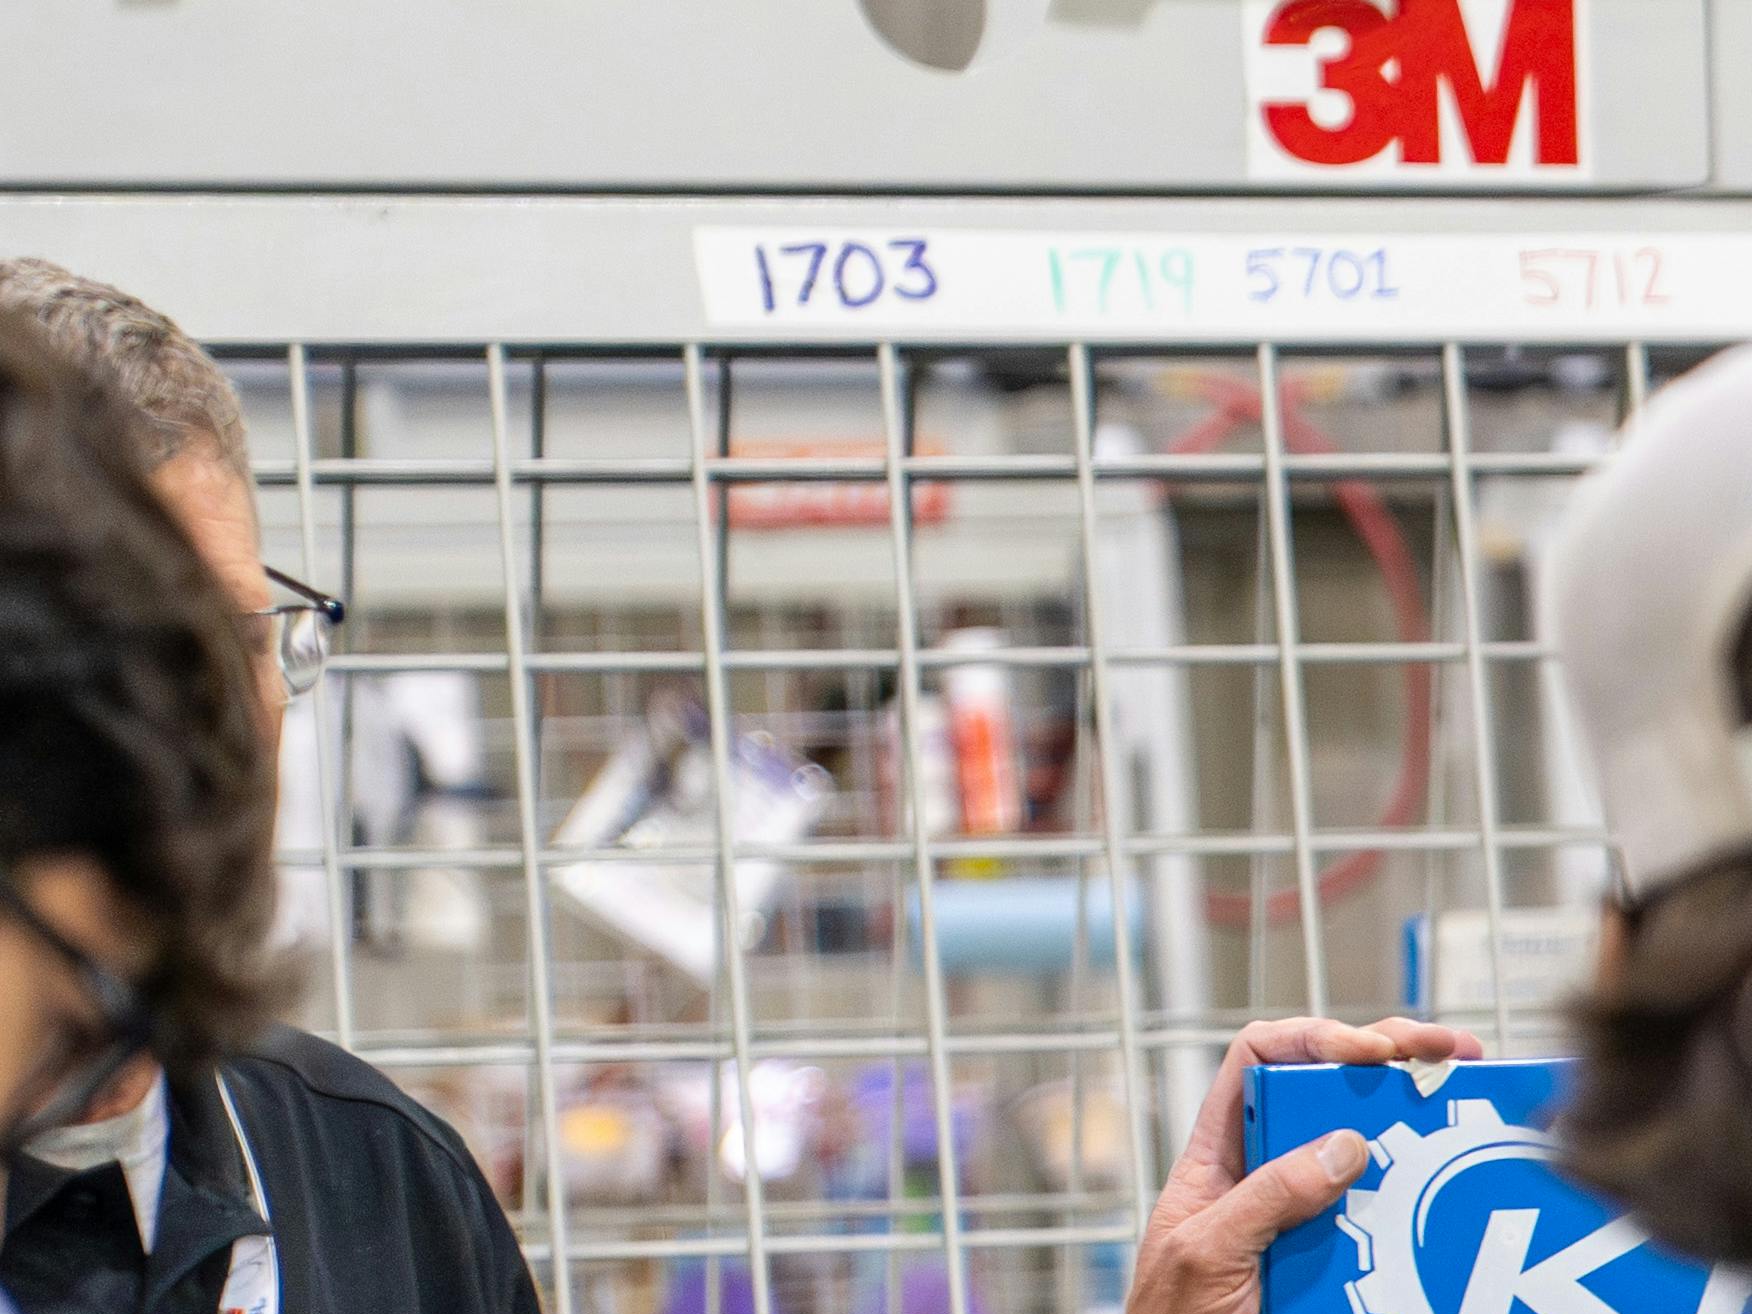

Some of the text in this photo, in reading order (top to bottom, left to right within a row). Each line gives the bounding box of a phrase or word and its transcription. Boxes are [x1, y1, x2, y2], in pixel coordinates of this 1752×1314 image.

[1262, 0, 1578, 165] 3M
[754, 239, 1670, 315] 1703 1719 5701 5712
